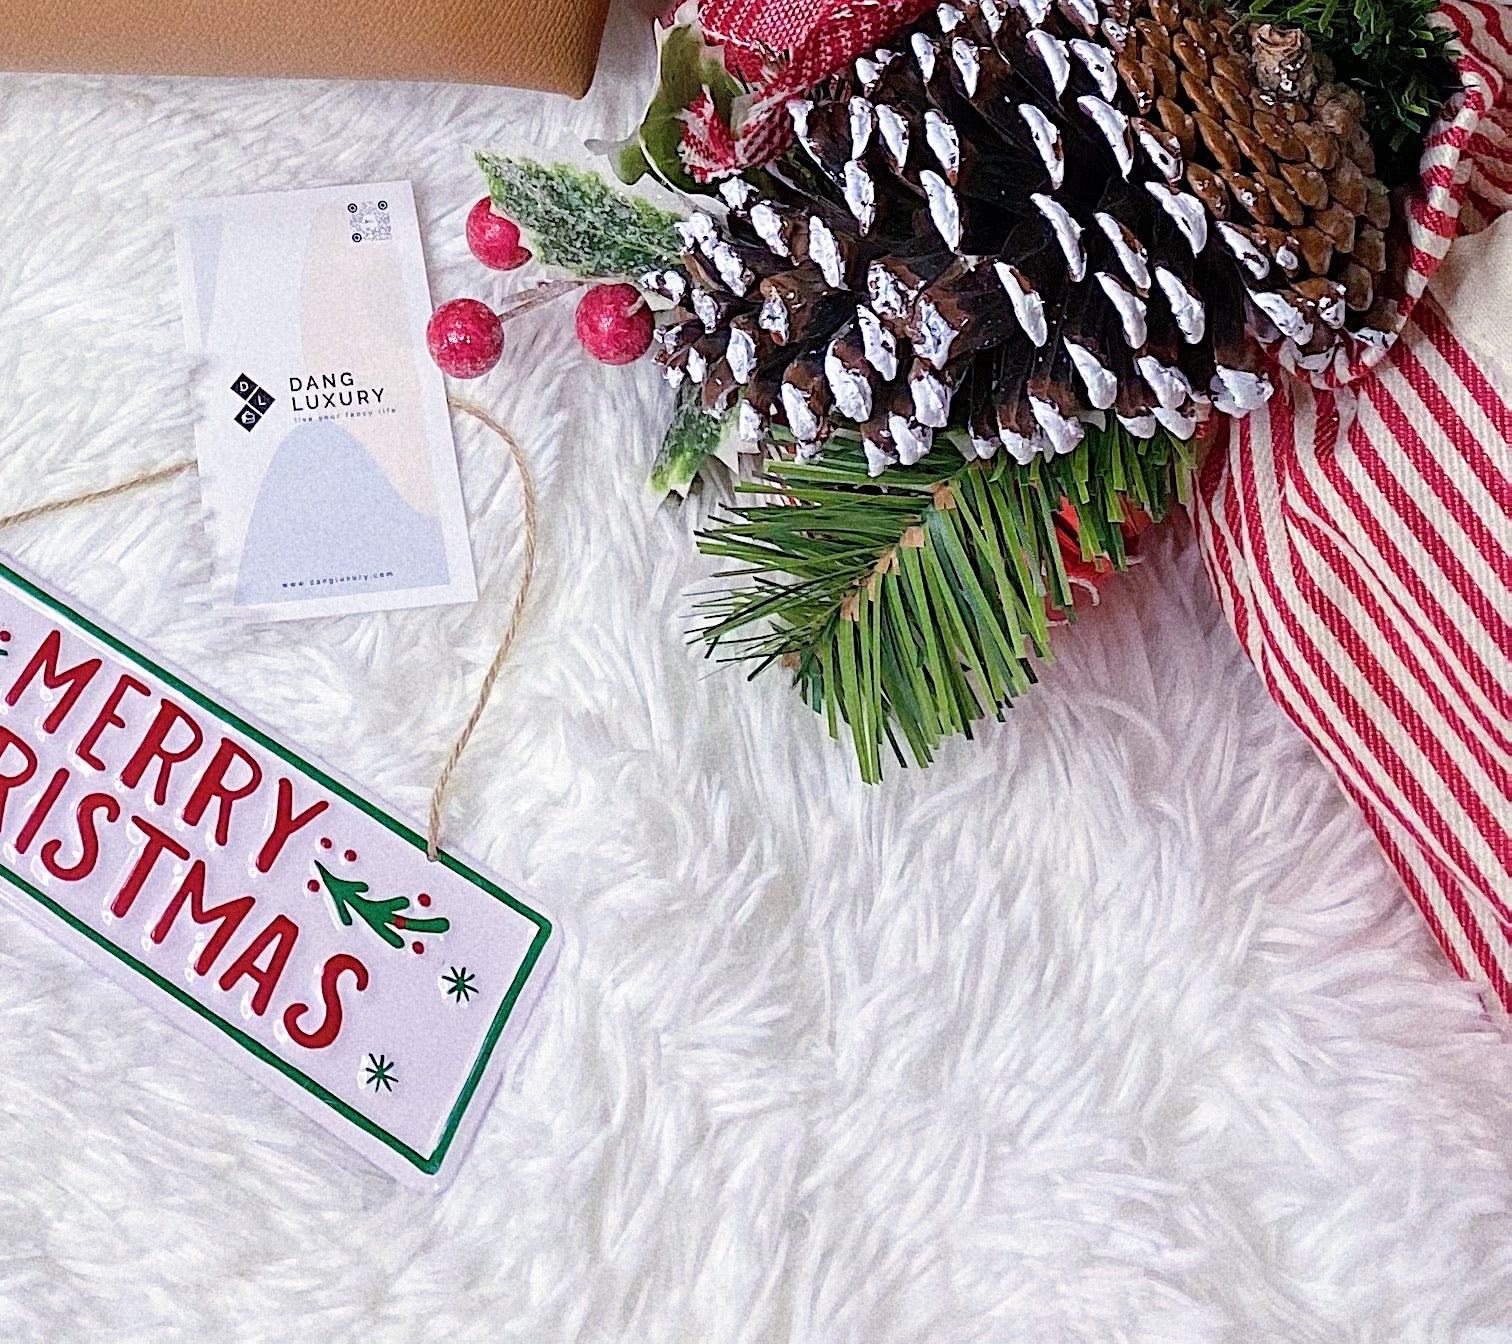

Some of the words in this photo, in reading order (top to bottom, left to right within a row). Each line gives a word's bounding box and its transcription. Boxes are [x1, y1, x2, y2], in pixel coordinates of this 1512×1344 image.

[289, 372, 354, 392] DANG
[292, 387, 384, 412] LUXURY
[5, 629, 329, 874] MERRY
